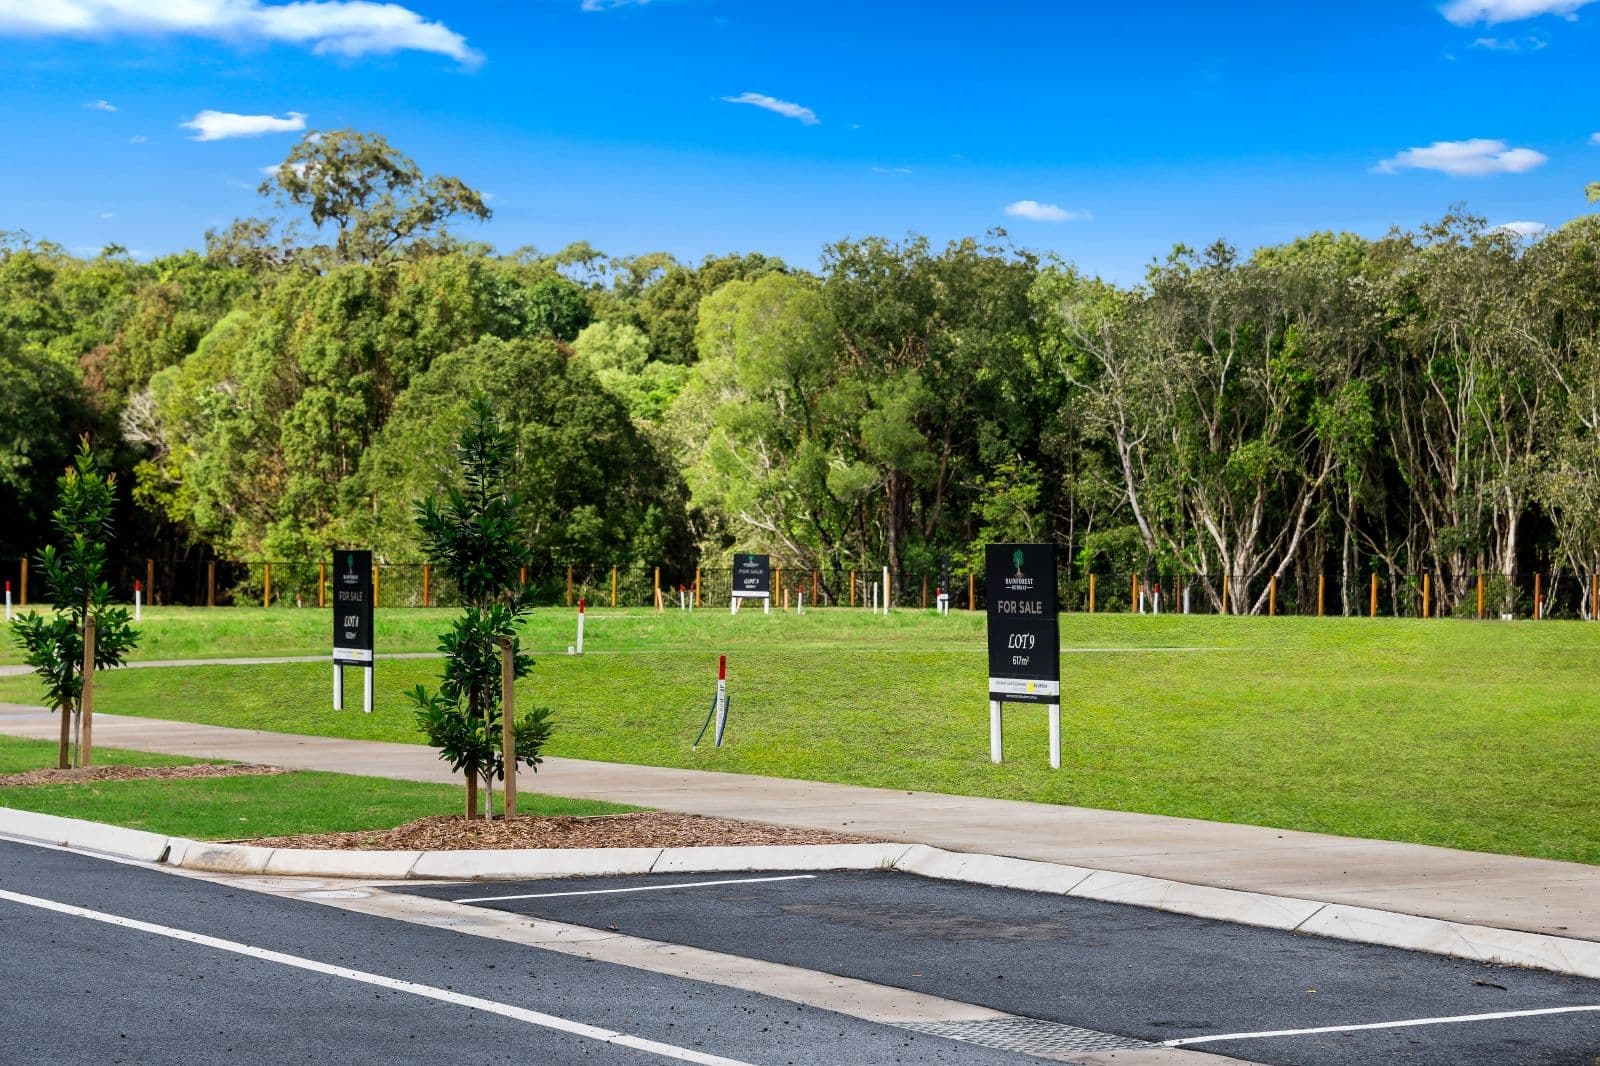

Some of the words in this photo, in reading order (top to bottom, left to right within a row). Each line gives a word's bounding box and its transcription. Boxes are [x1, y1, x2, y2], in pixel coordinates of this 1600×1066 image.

[339, 591, 350, 601] FOR
[350, 592, 363, 602] SALE
[998, 600, 1017, 614] FOR
[1019, 601, 1043, 614] SALE
[1008, 633, 1030, 649] LOT
[1029, 634, 1035, 649] 9
